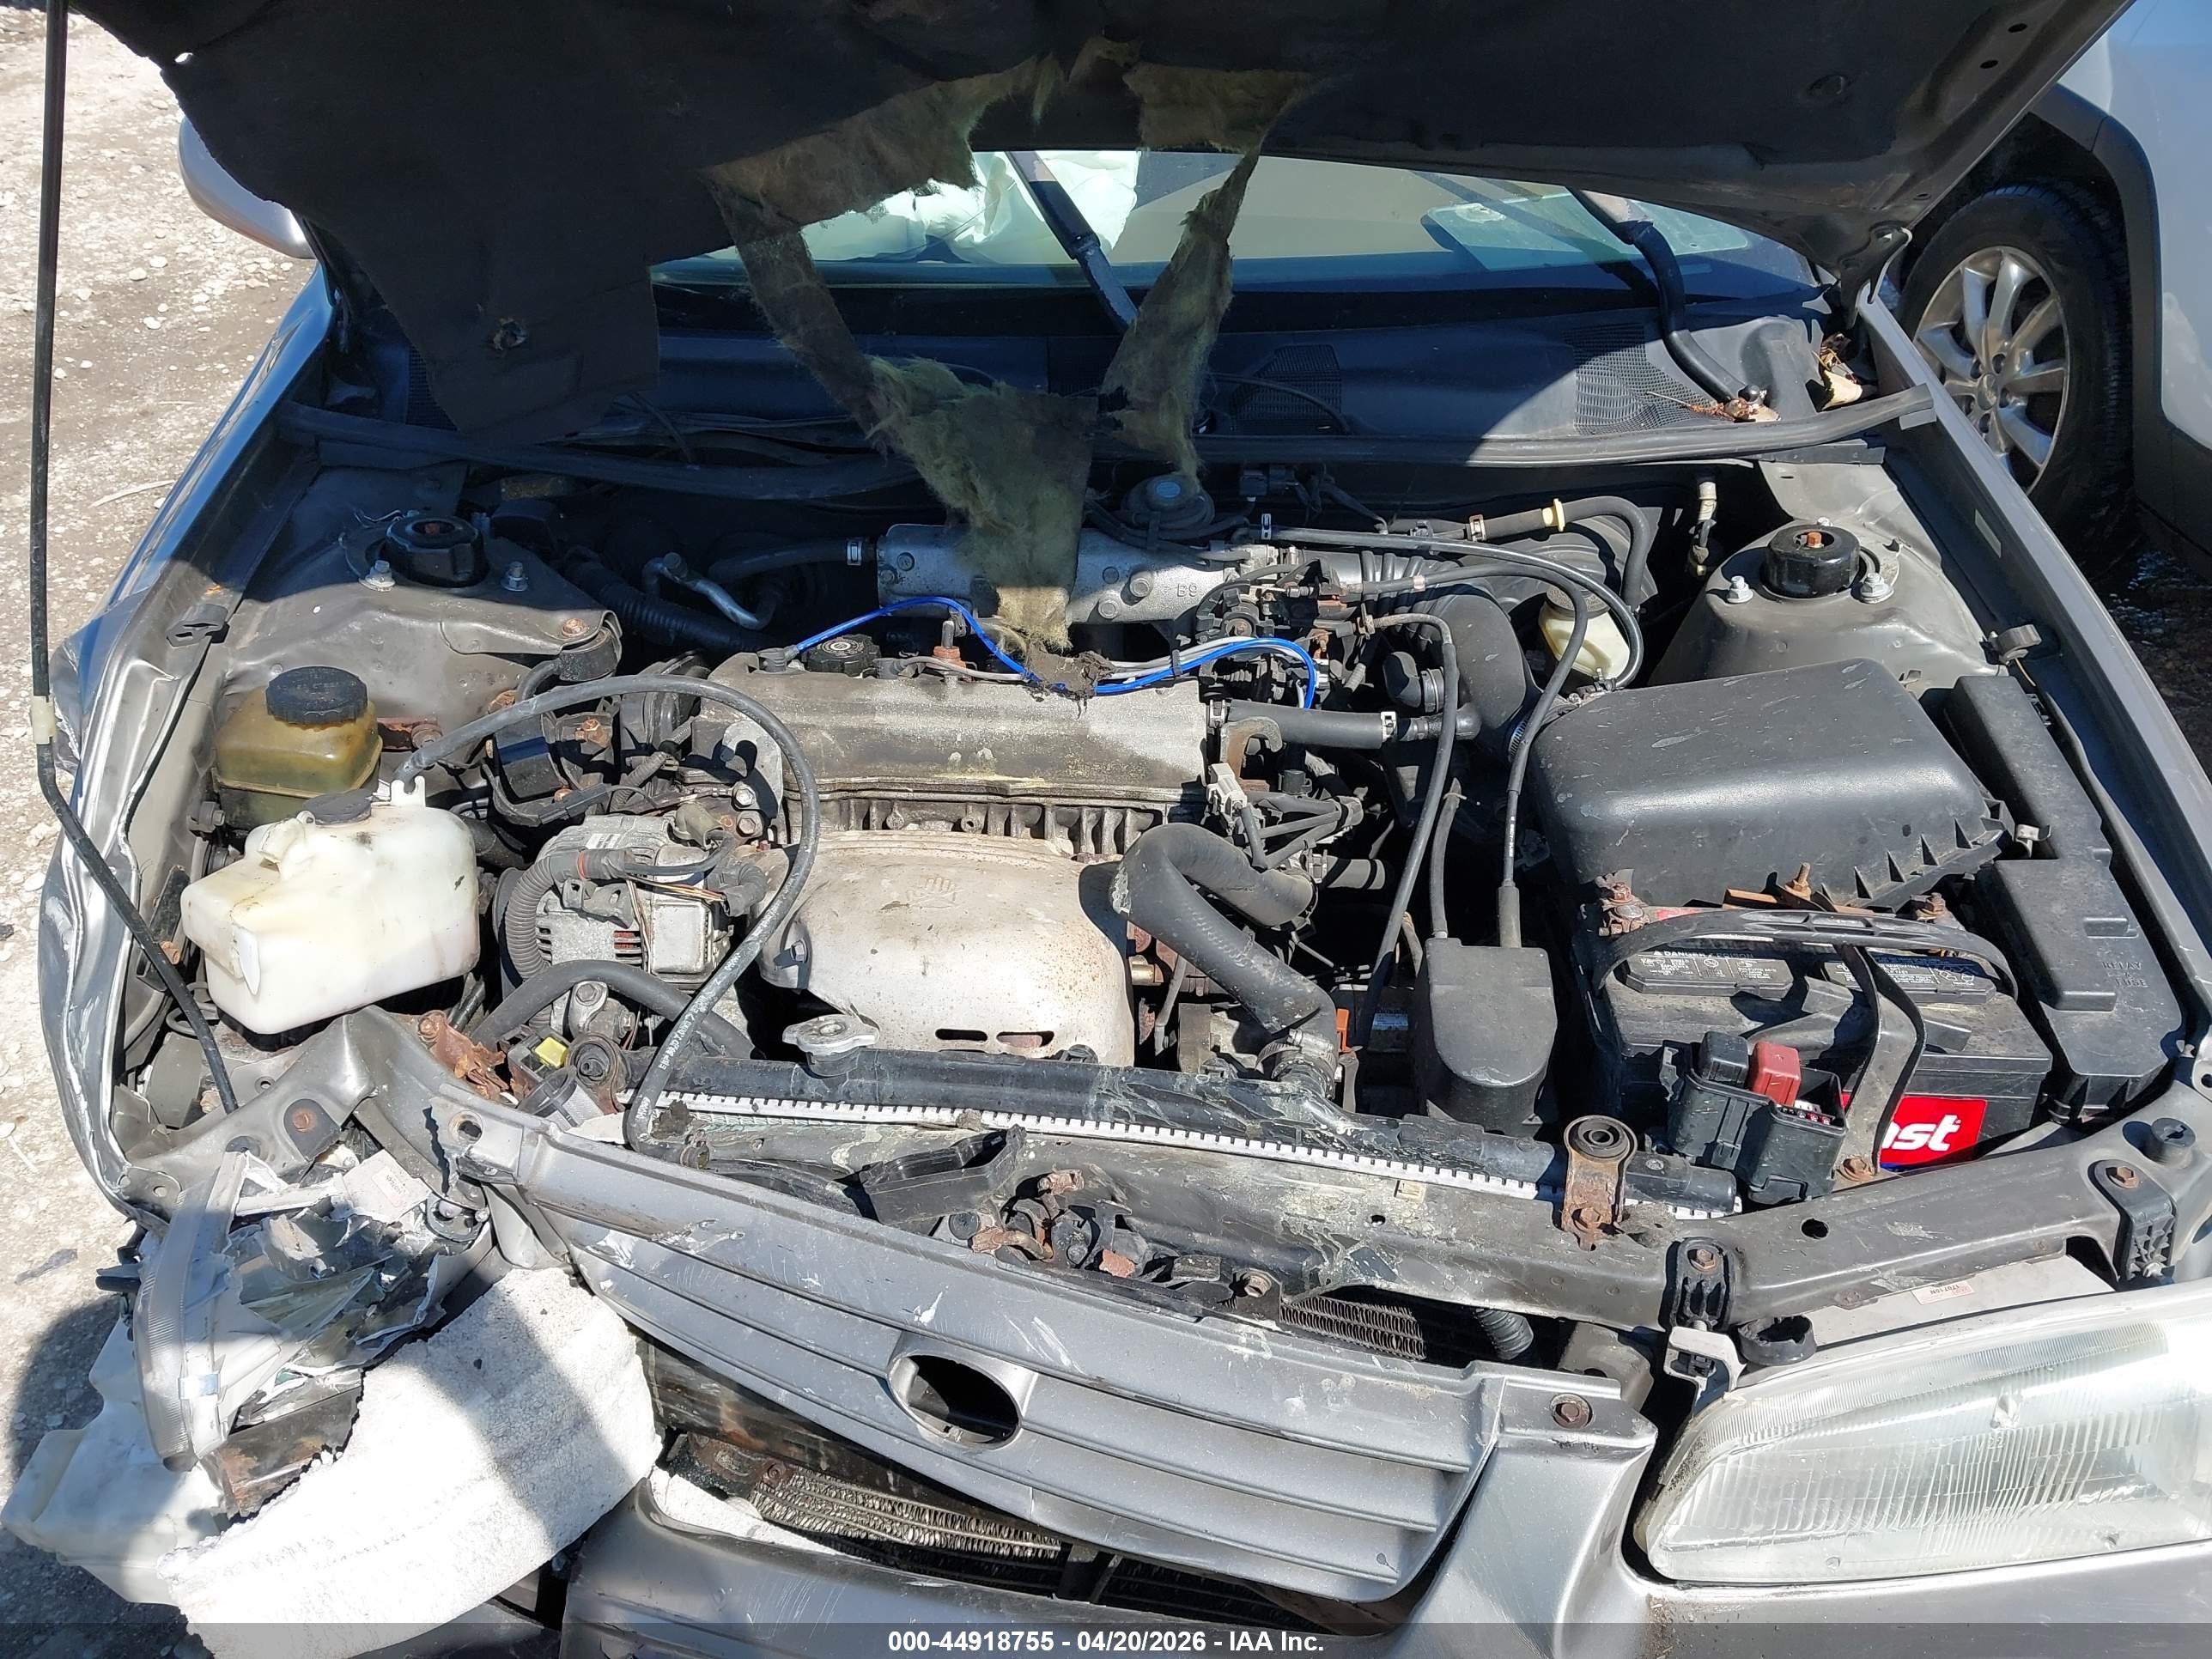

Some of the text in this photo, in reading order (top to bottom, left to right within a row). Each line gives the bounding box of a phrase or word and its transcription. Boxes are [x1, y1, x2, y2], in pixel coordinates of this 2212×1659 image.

[1177, 582, 1198, 598] B9
[2101, 961, 2143, 970] RELAY
[2115, 978, 2149, 989] FUSE
